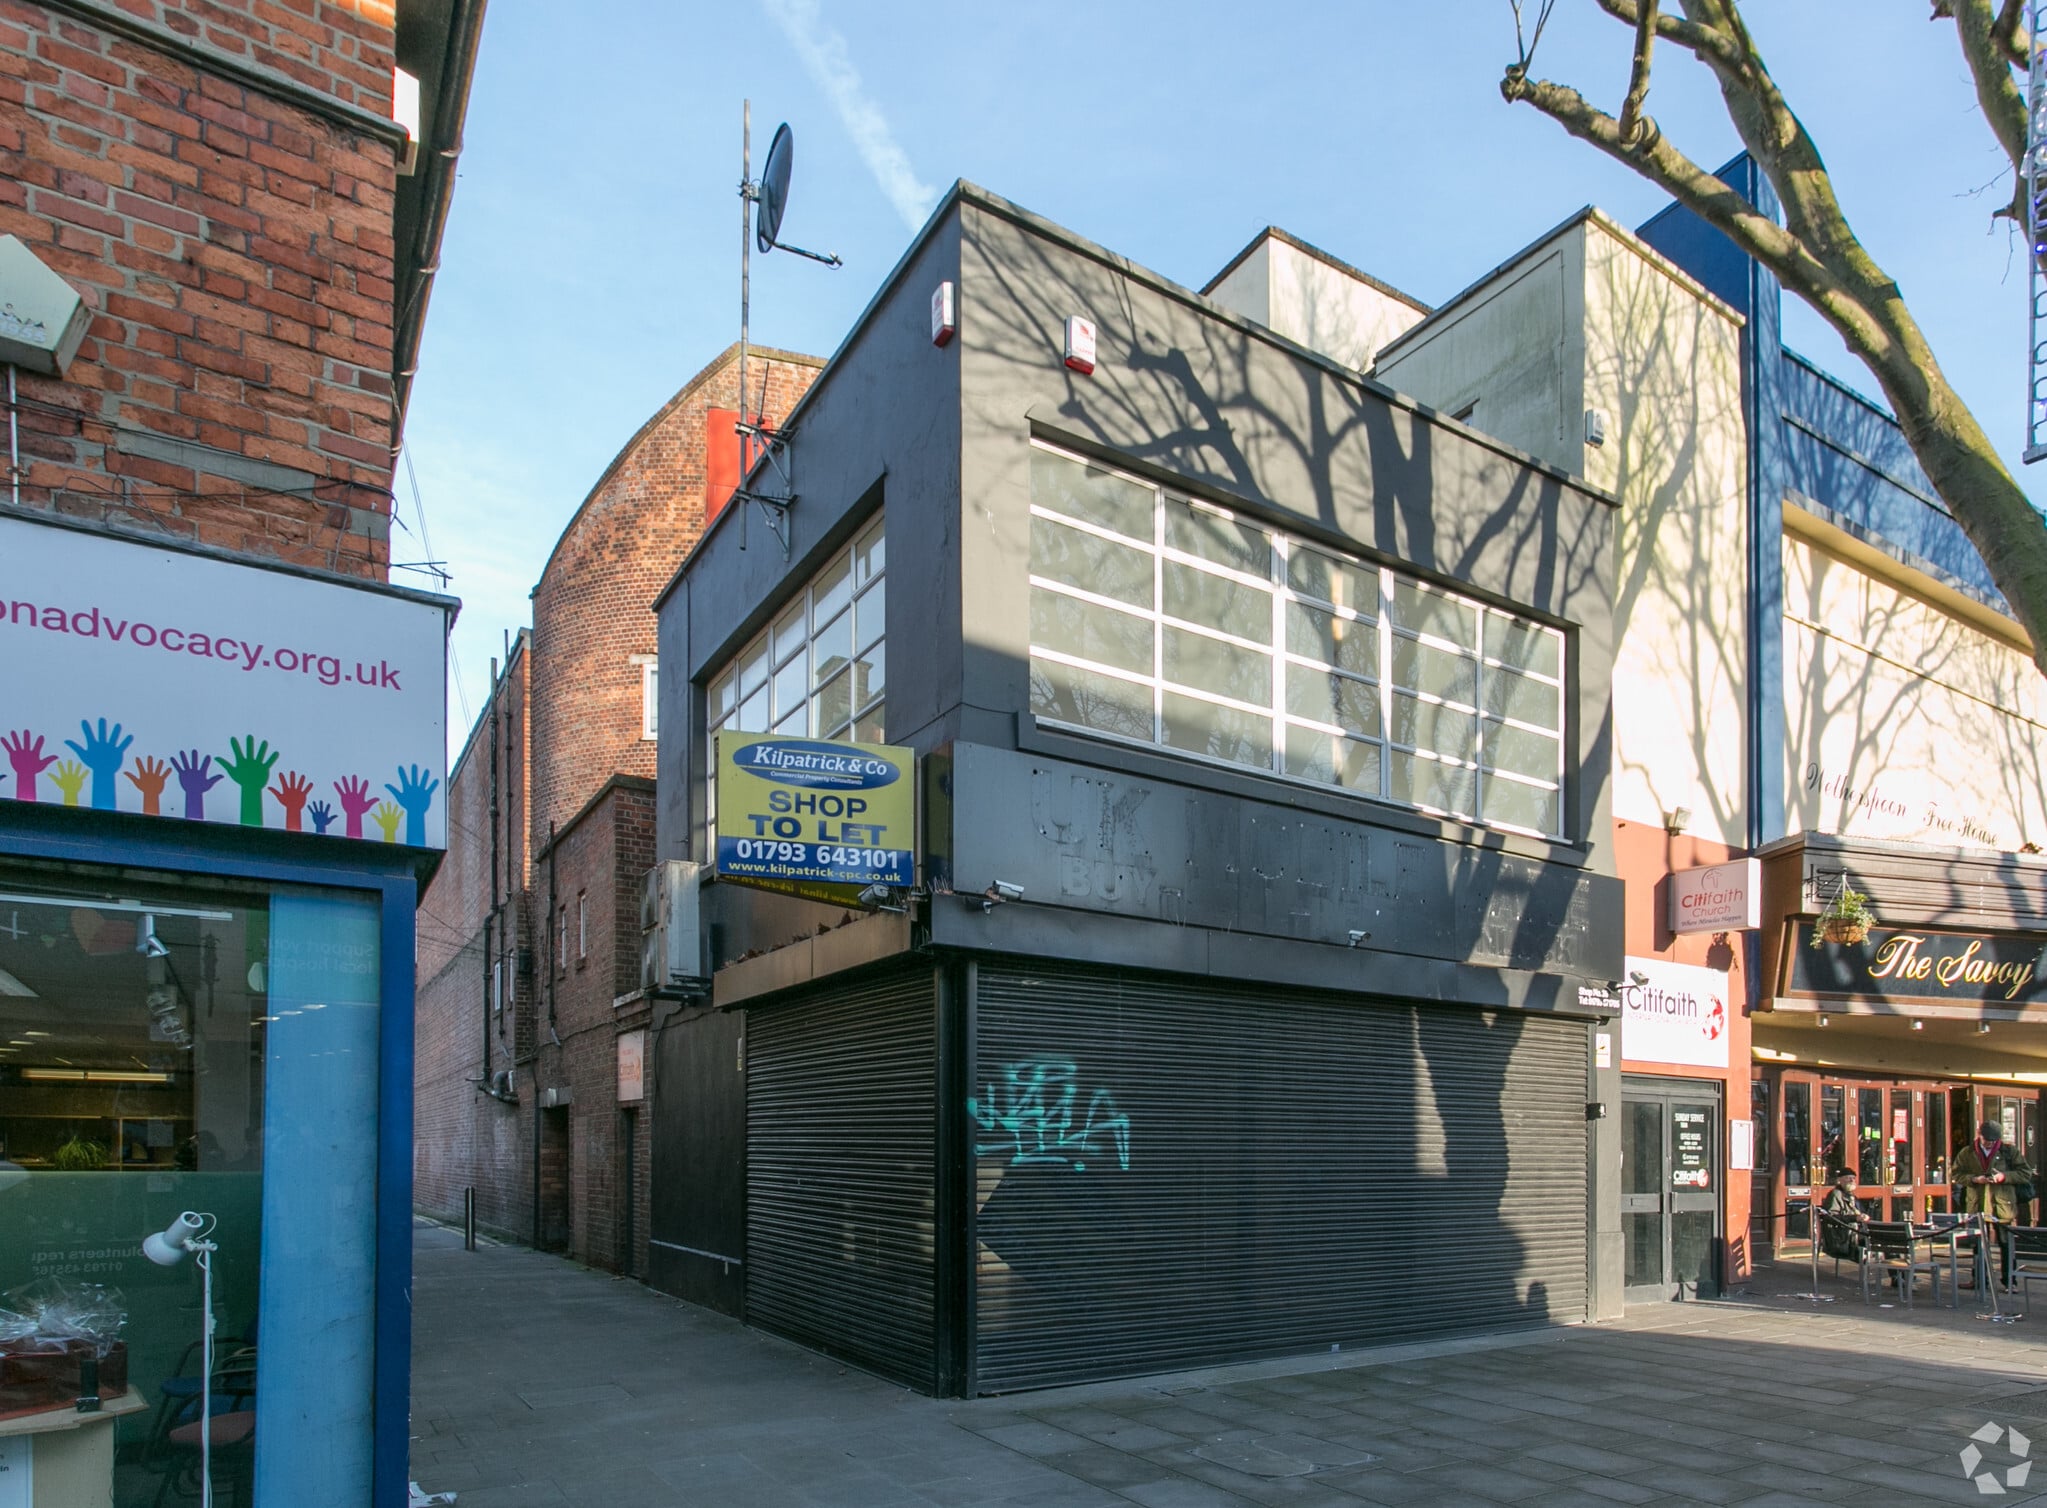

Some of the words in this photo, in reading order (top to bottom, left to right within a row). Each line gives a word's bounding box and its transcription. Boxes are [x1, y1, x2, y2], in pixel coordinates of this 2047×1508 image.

[0, 599, 402, 691] nadvocacy.org.uk
[753, 746, 845, 772] Kilpatrick
[847, 758, 863, 774] &
[865, 760, 888, 775] Co
[770, 771, 805, 780] Commercial
[805, 773, 830, 783] Property
[830, 776, 863, 785] Consultants
[768, 790, 868, 818] SHOP
[748, 814, 802, 839] TO
[818, 821, 887, 846] LET
[1923, 801, 1954, 831] Free
[1957, 815, 1999, 847] House
[737, 839, 806, 862] 01793
[816, 848, 897, 869] 643101
[728, 862, 902, 882] www.kilpatrick-cpc.co.uk
[1681, 889, 1744, 909] Citifaith
[1692, 905, 1731, 918] Church
[1867, 935, 1933, 980] The
[1936, 940, 2034, 1001] Savoy
[1626, 985, 1698, 1018] Citifaith
